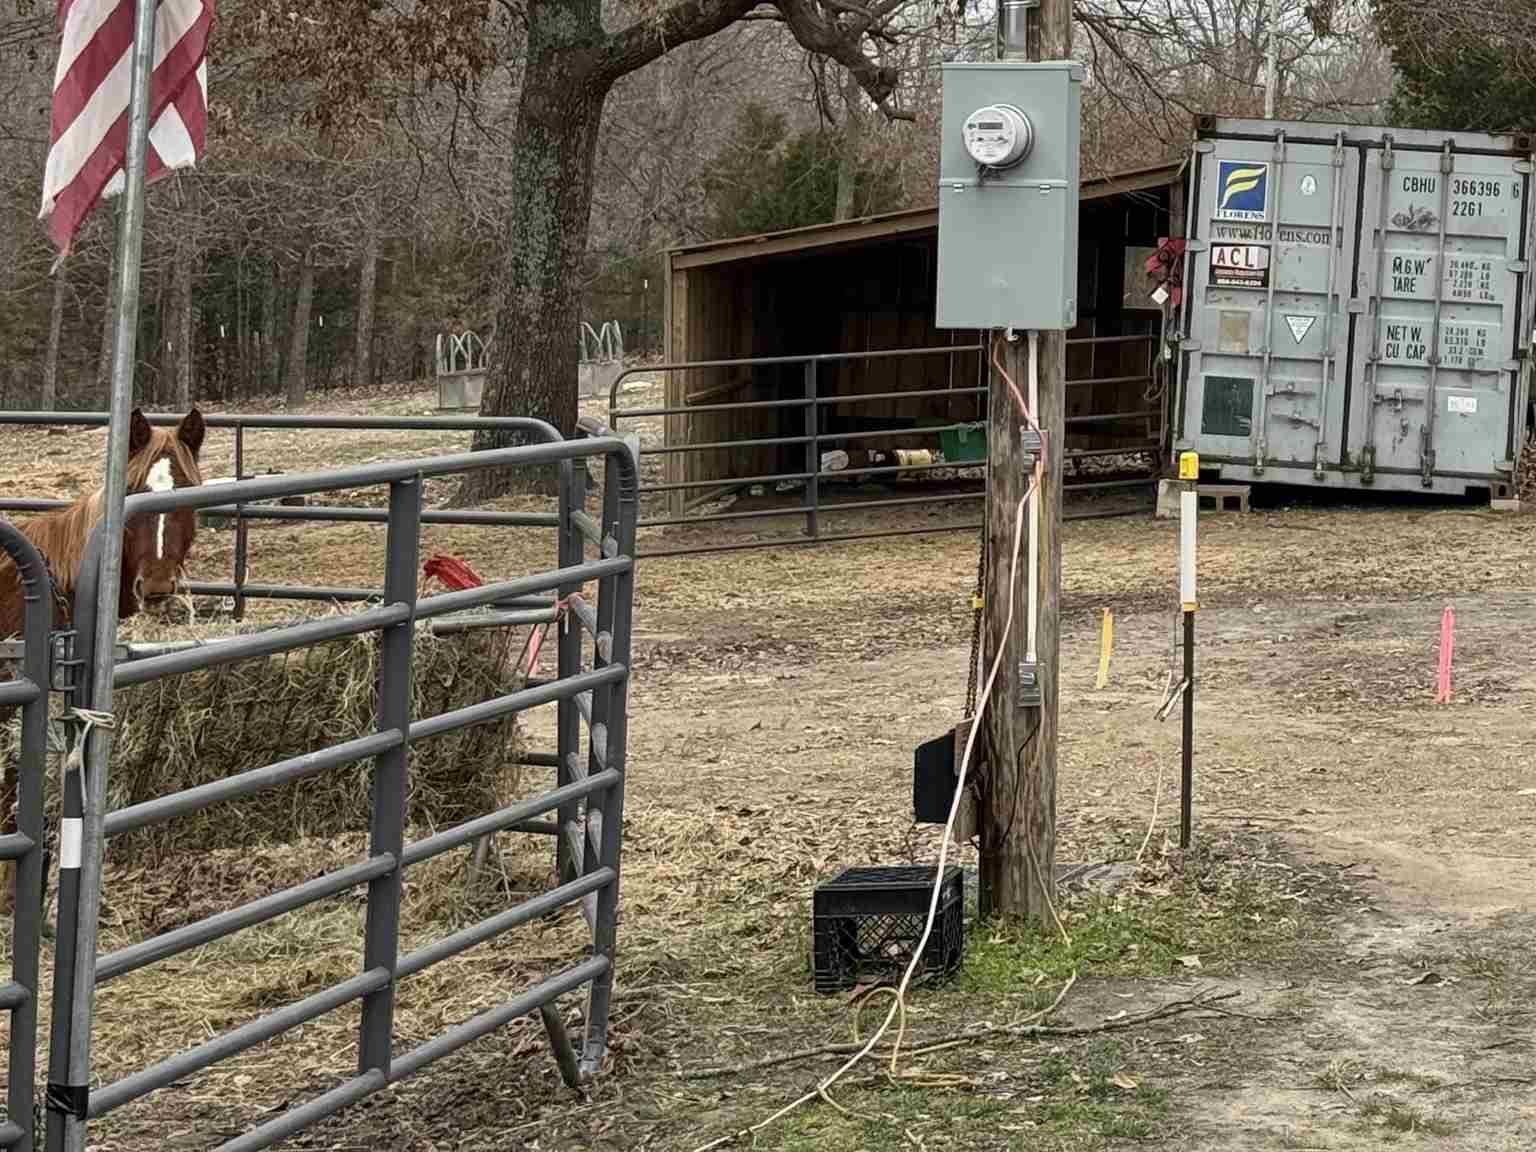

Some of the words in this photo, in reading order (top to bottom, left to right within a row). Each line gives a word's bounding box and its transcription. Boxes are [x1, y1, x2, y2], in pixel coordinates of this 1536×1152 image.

[1402, 176, 1436, 194] CBHU
[1452, 179, 1501, 197] 366396
[1216, 209, 1265, 219] FLORENS
[1391, 276, 1417, 293] TARE
[1386, 325, 1408, 341] NET
